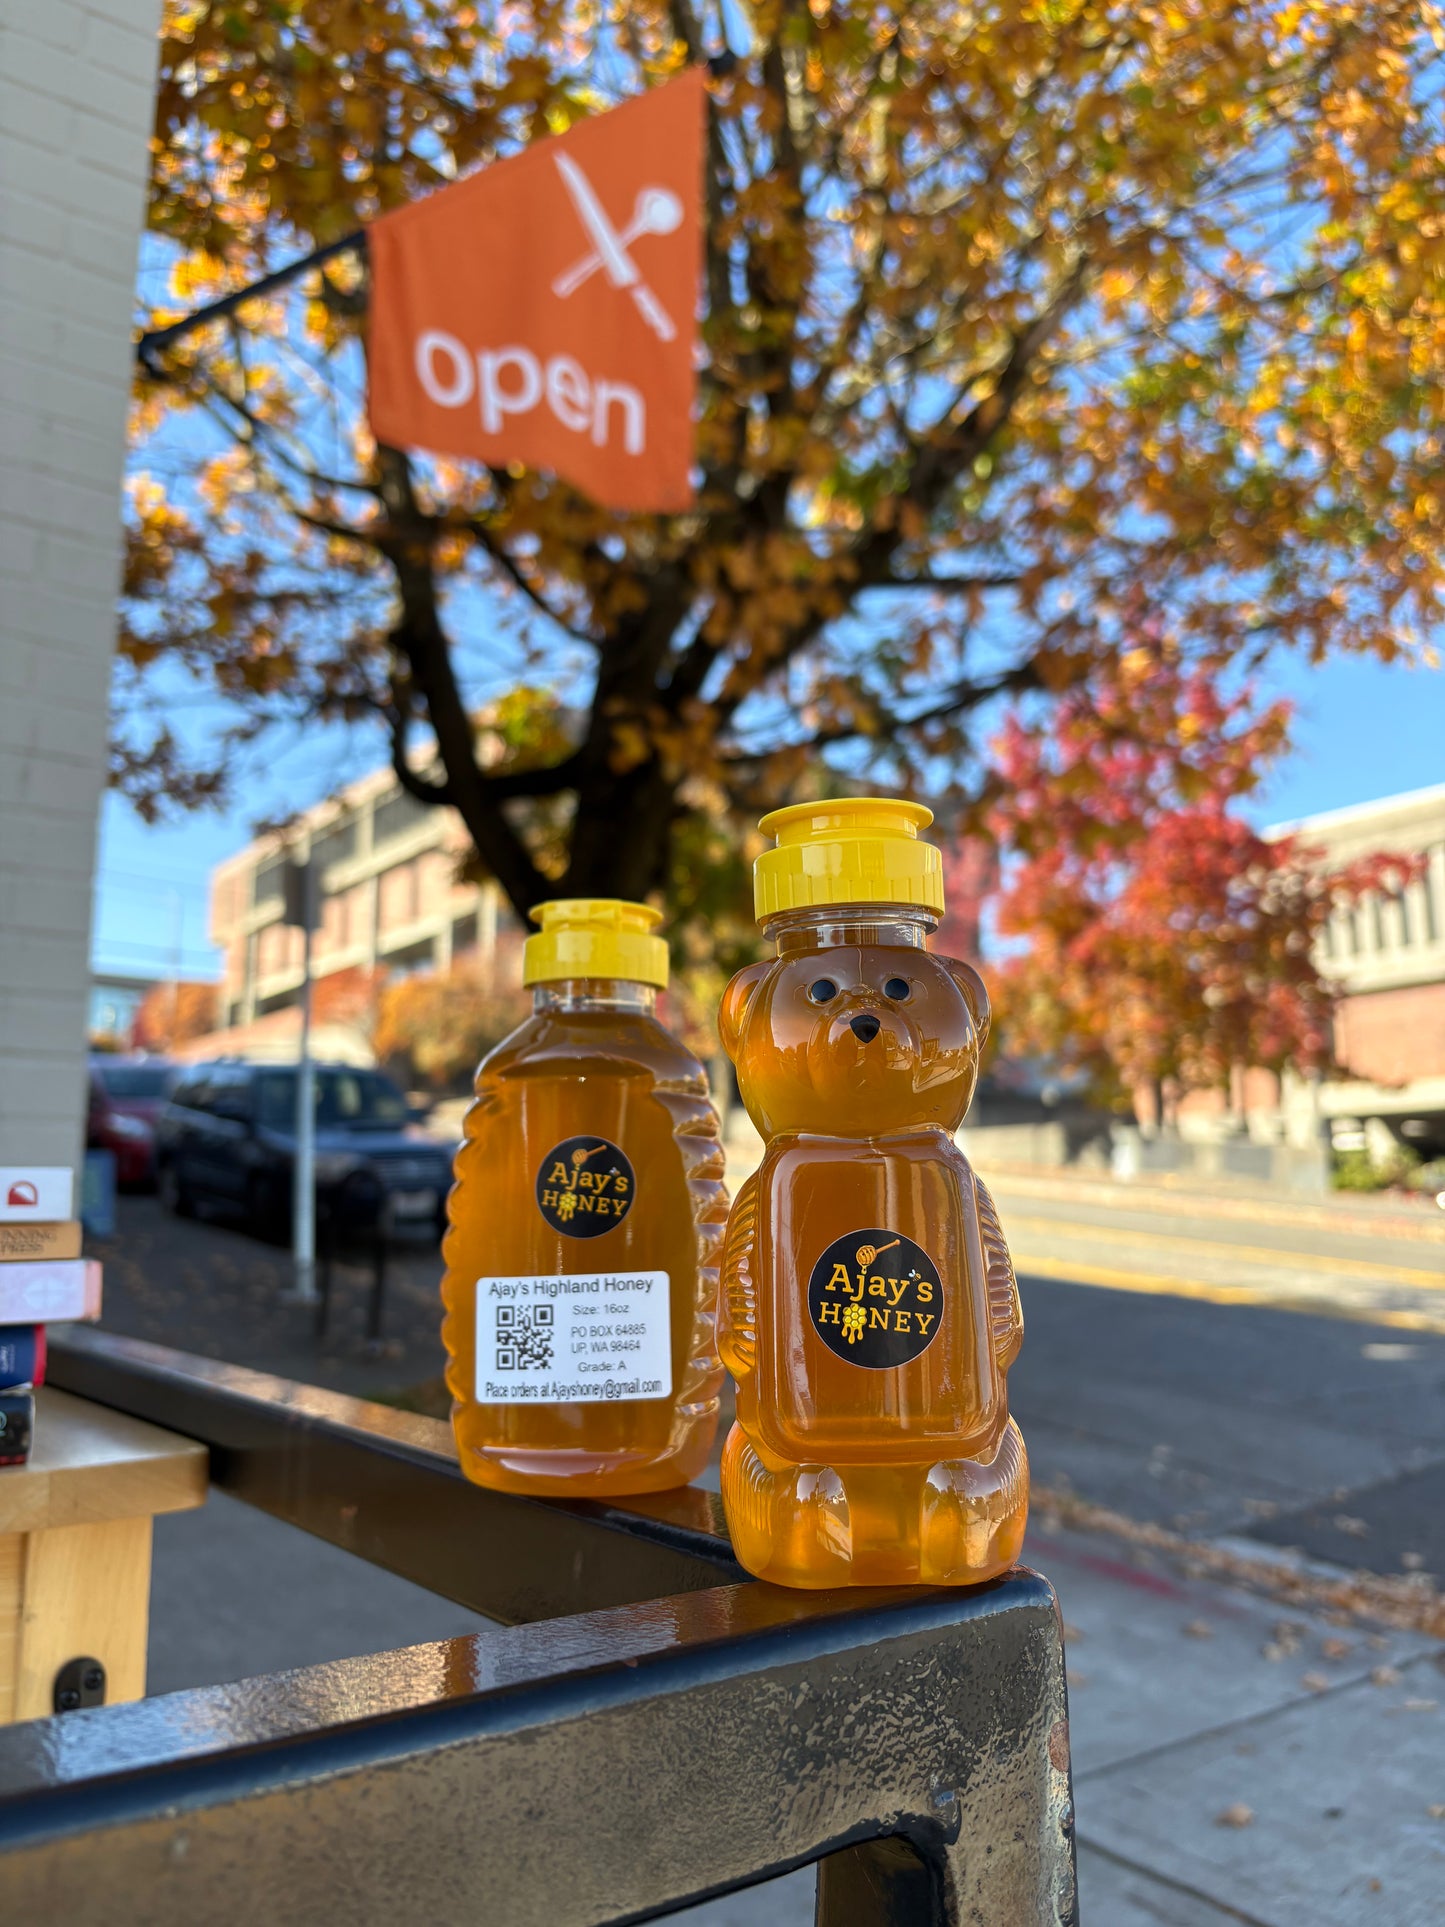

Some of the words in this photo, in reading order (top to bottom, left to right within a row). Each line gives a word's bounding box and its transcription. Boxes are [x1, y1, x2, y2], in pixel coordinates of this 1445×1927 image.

[414, 328, 646, 456] open
[547, 1161, 629, 1195] Ajay's
[489, 1281, 529, 1299] Ajay's
[534, 1279, 600, 1298] Highland
[604, 1277, 653, 1293] Honey
[824, 1263, 934, 1306] Ajay's
[572, 1304, 599, 1316] Size:
[604, 1303, 630, 1314] 16oz
[571, 1326, 587, 1338] PO
[589, 1325, 613, 1337] BOX
[591, 1341, 609, 1353] WA
[577, 1361, 615, 1373] Grade:
[617, 1360, 627, 1371] A
[485, 1381, 508, 1397] Place
[510, 1381, 538, 1397] orders
